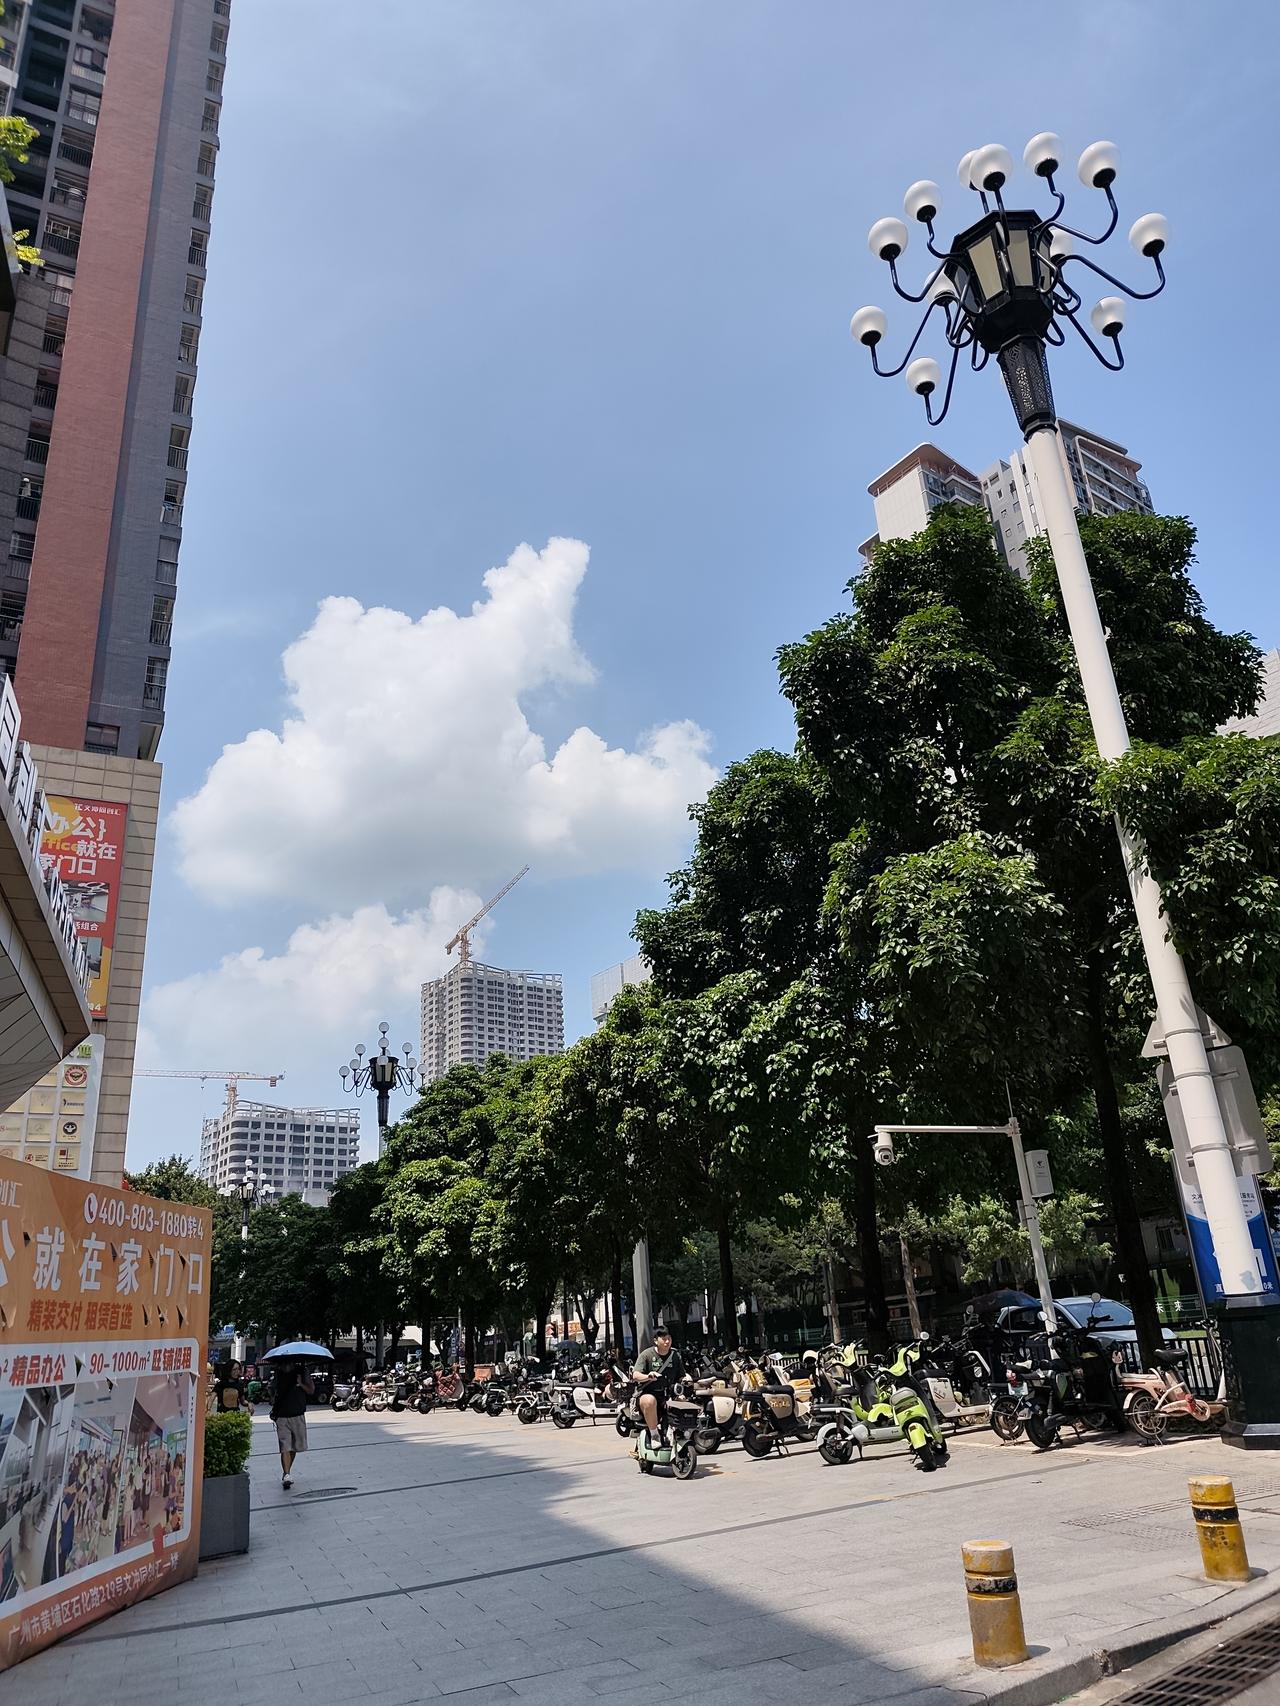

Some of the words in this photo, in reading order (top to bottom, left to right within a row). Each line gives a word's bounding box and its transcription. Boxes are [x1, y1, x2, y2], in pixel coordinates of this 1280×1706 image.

[77, 839, 117, 860] 就在
[26, 1299, 83, 1332] 精装交付
[84, 1301, 133, 1332] 租赁首选
[9, 1354, 66, 1387] 精品办公
[151, 1346, 192, 1372] 旺铺招租
